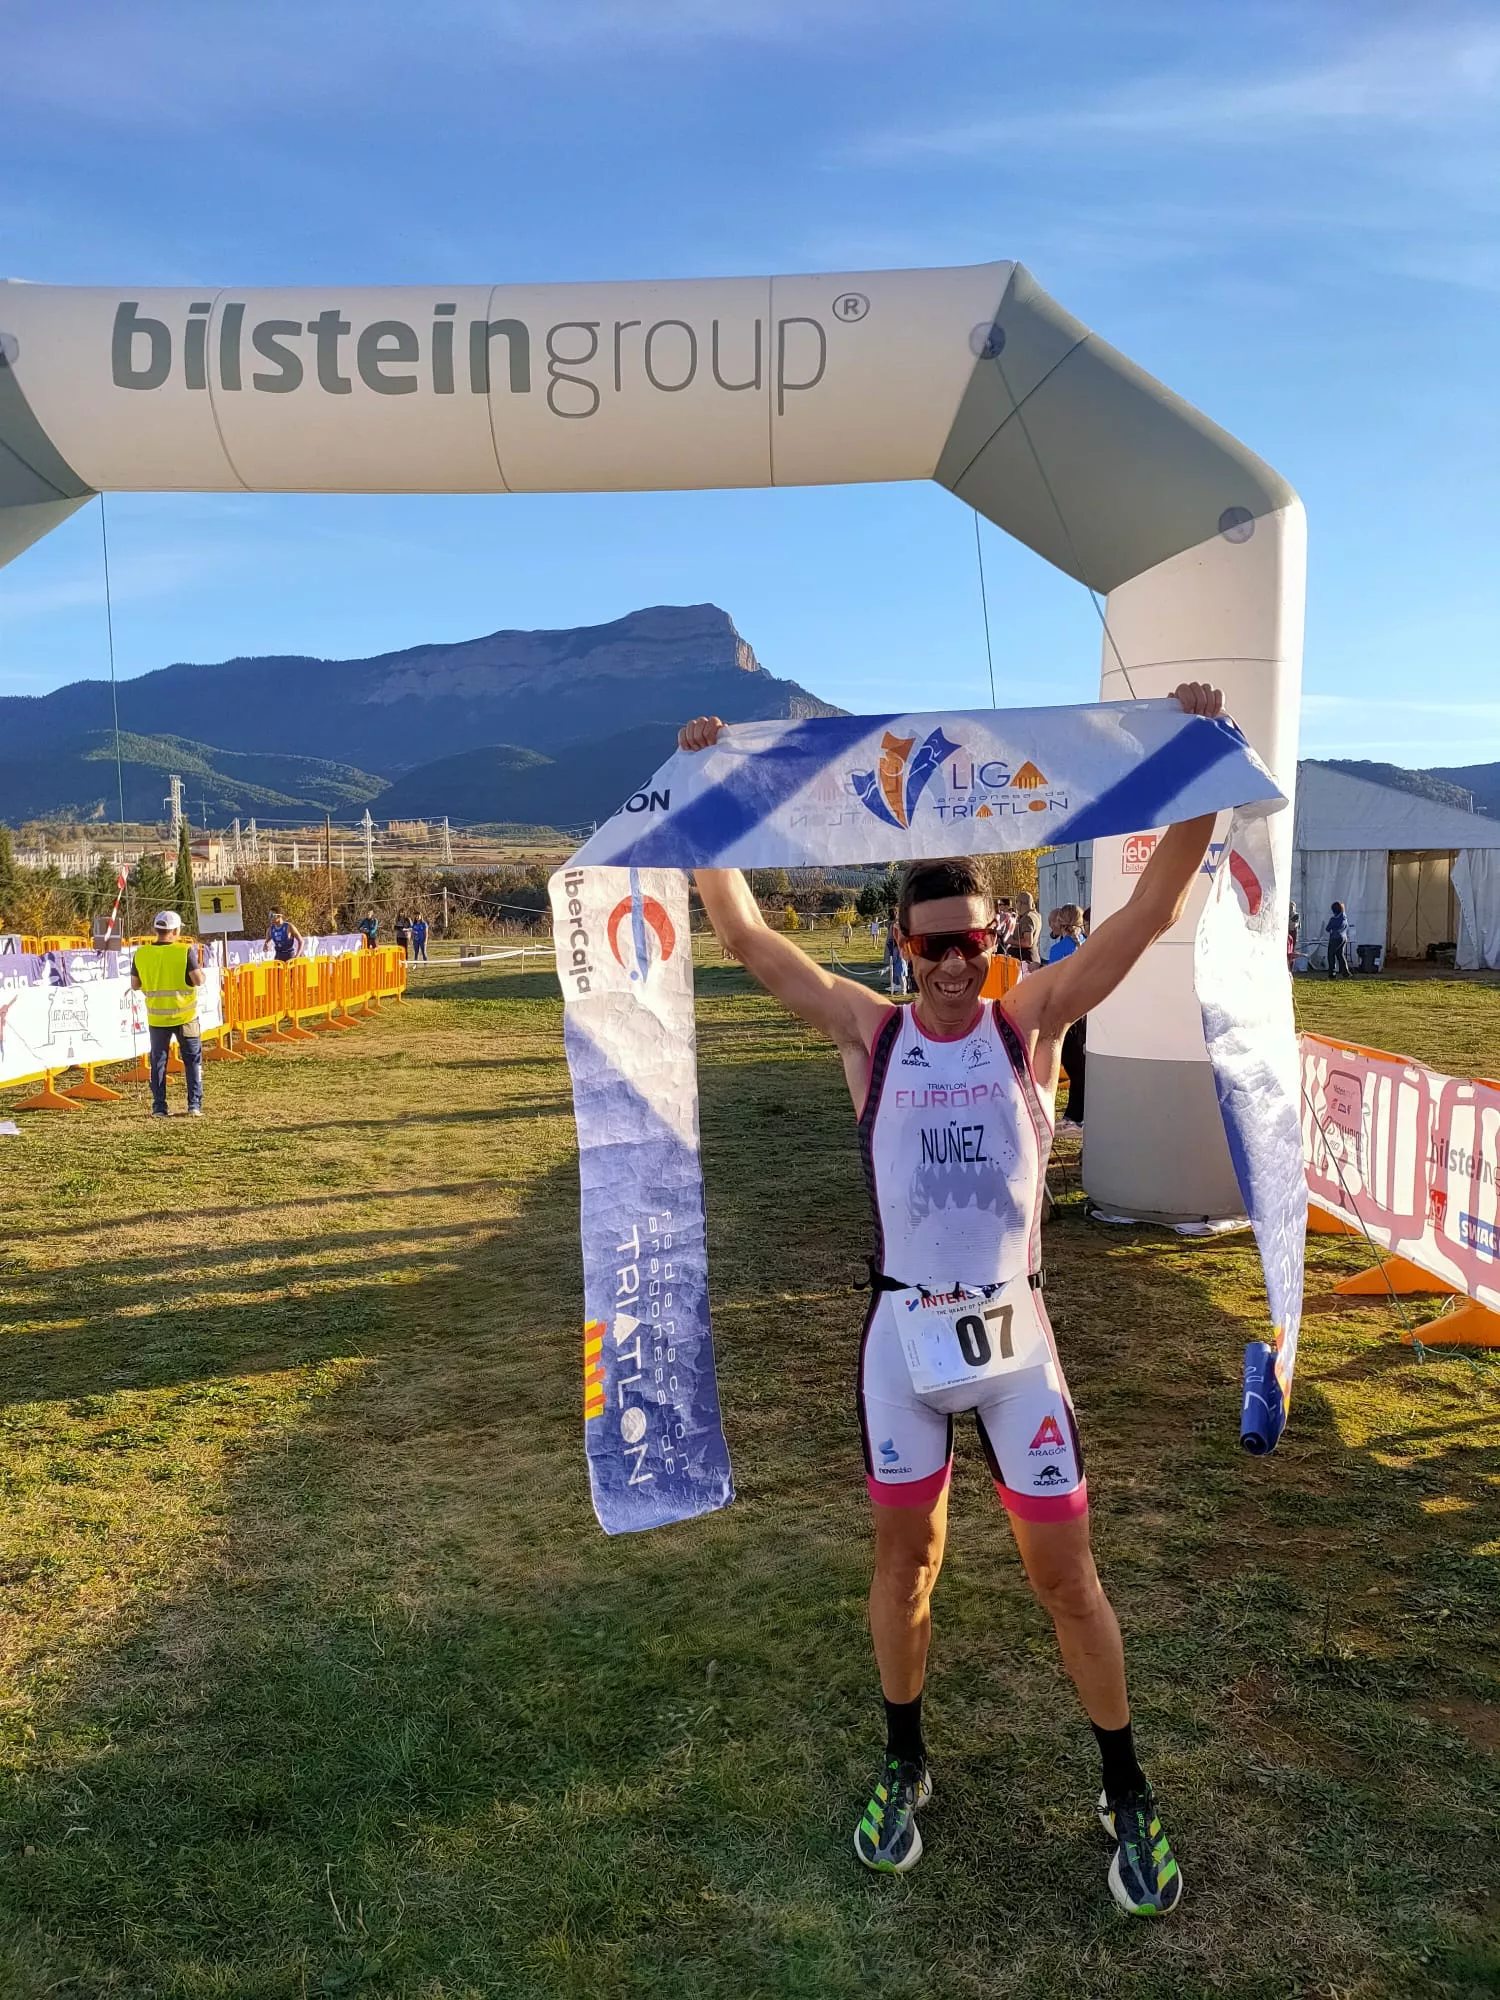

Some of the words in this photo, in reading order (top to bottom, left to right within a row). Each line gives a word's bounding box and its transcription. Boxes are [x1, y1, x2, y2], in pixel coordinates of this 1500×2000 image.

[933, 797, 1069, 820] TRIATLON
[895, 1081, 1007, 1109] EUROPA
[928, 1082, 967, 1091] TRIATLON
[921, 1119, 988, 1165] NUÑEZ
[615, 1224, 653, 1487] TRIATLON
[955, 1304, 1015, 1367] 07
[660, 1434, 676, 1476] de
